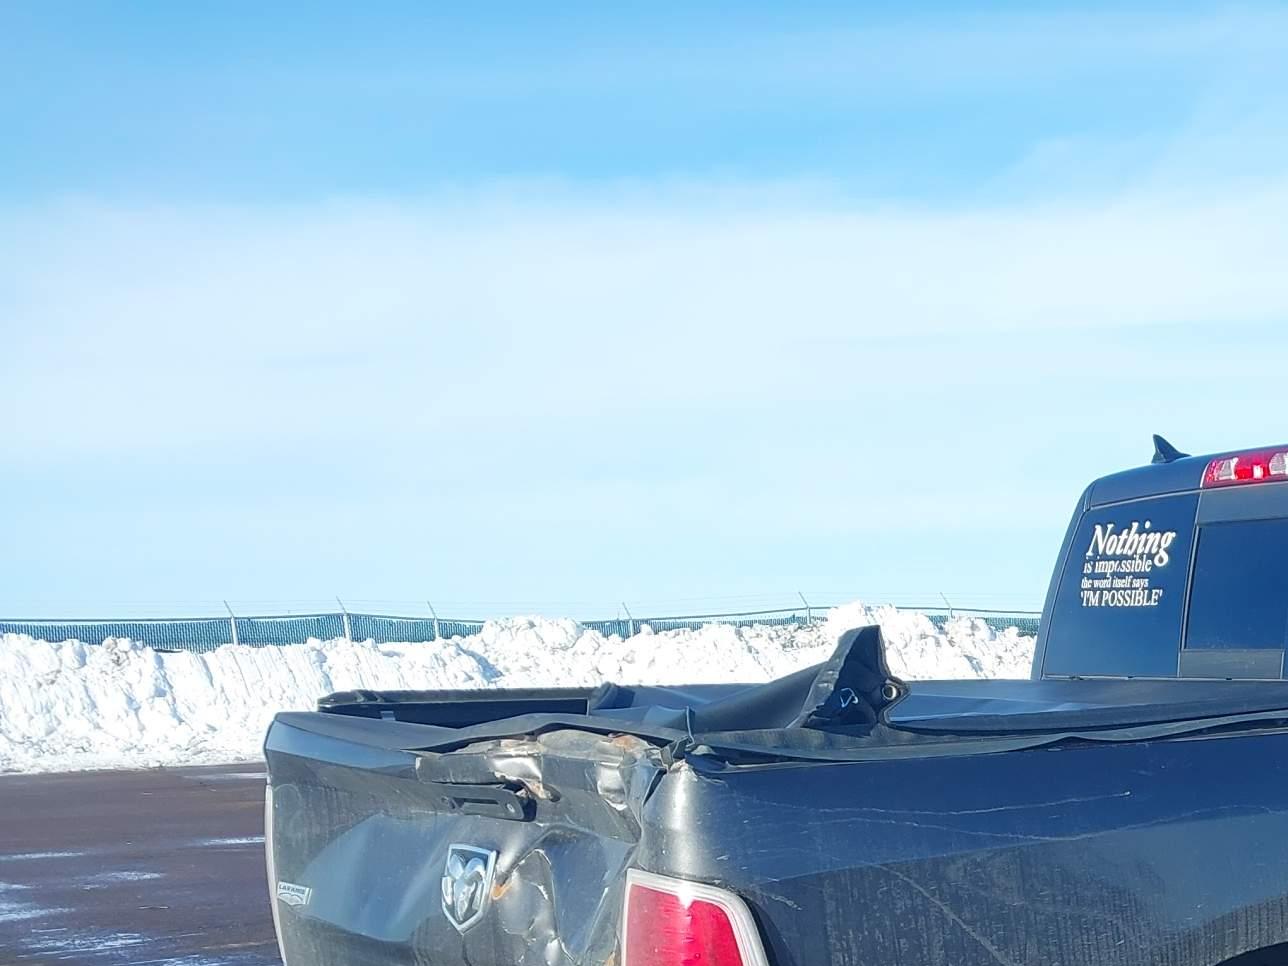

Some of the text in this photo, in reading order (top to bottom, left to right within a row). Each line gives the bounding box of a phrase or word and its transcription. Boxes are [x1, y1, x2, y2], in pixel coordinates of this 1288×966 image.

[1086, 520, 1176, 567] Nothing
[1083, 555, 1093, 573] is
[1081, 576, 1149, 592] the word itself says
